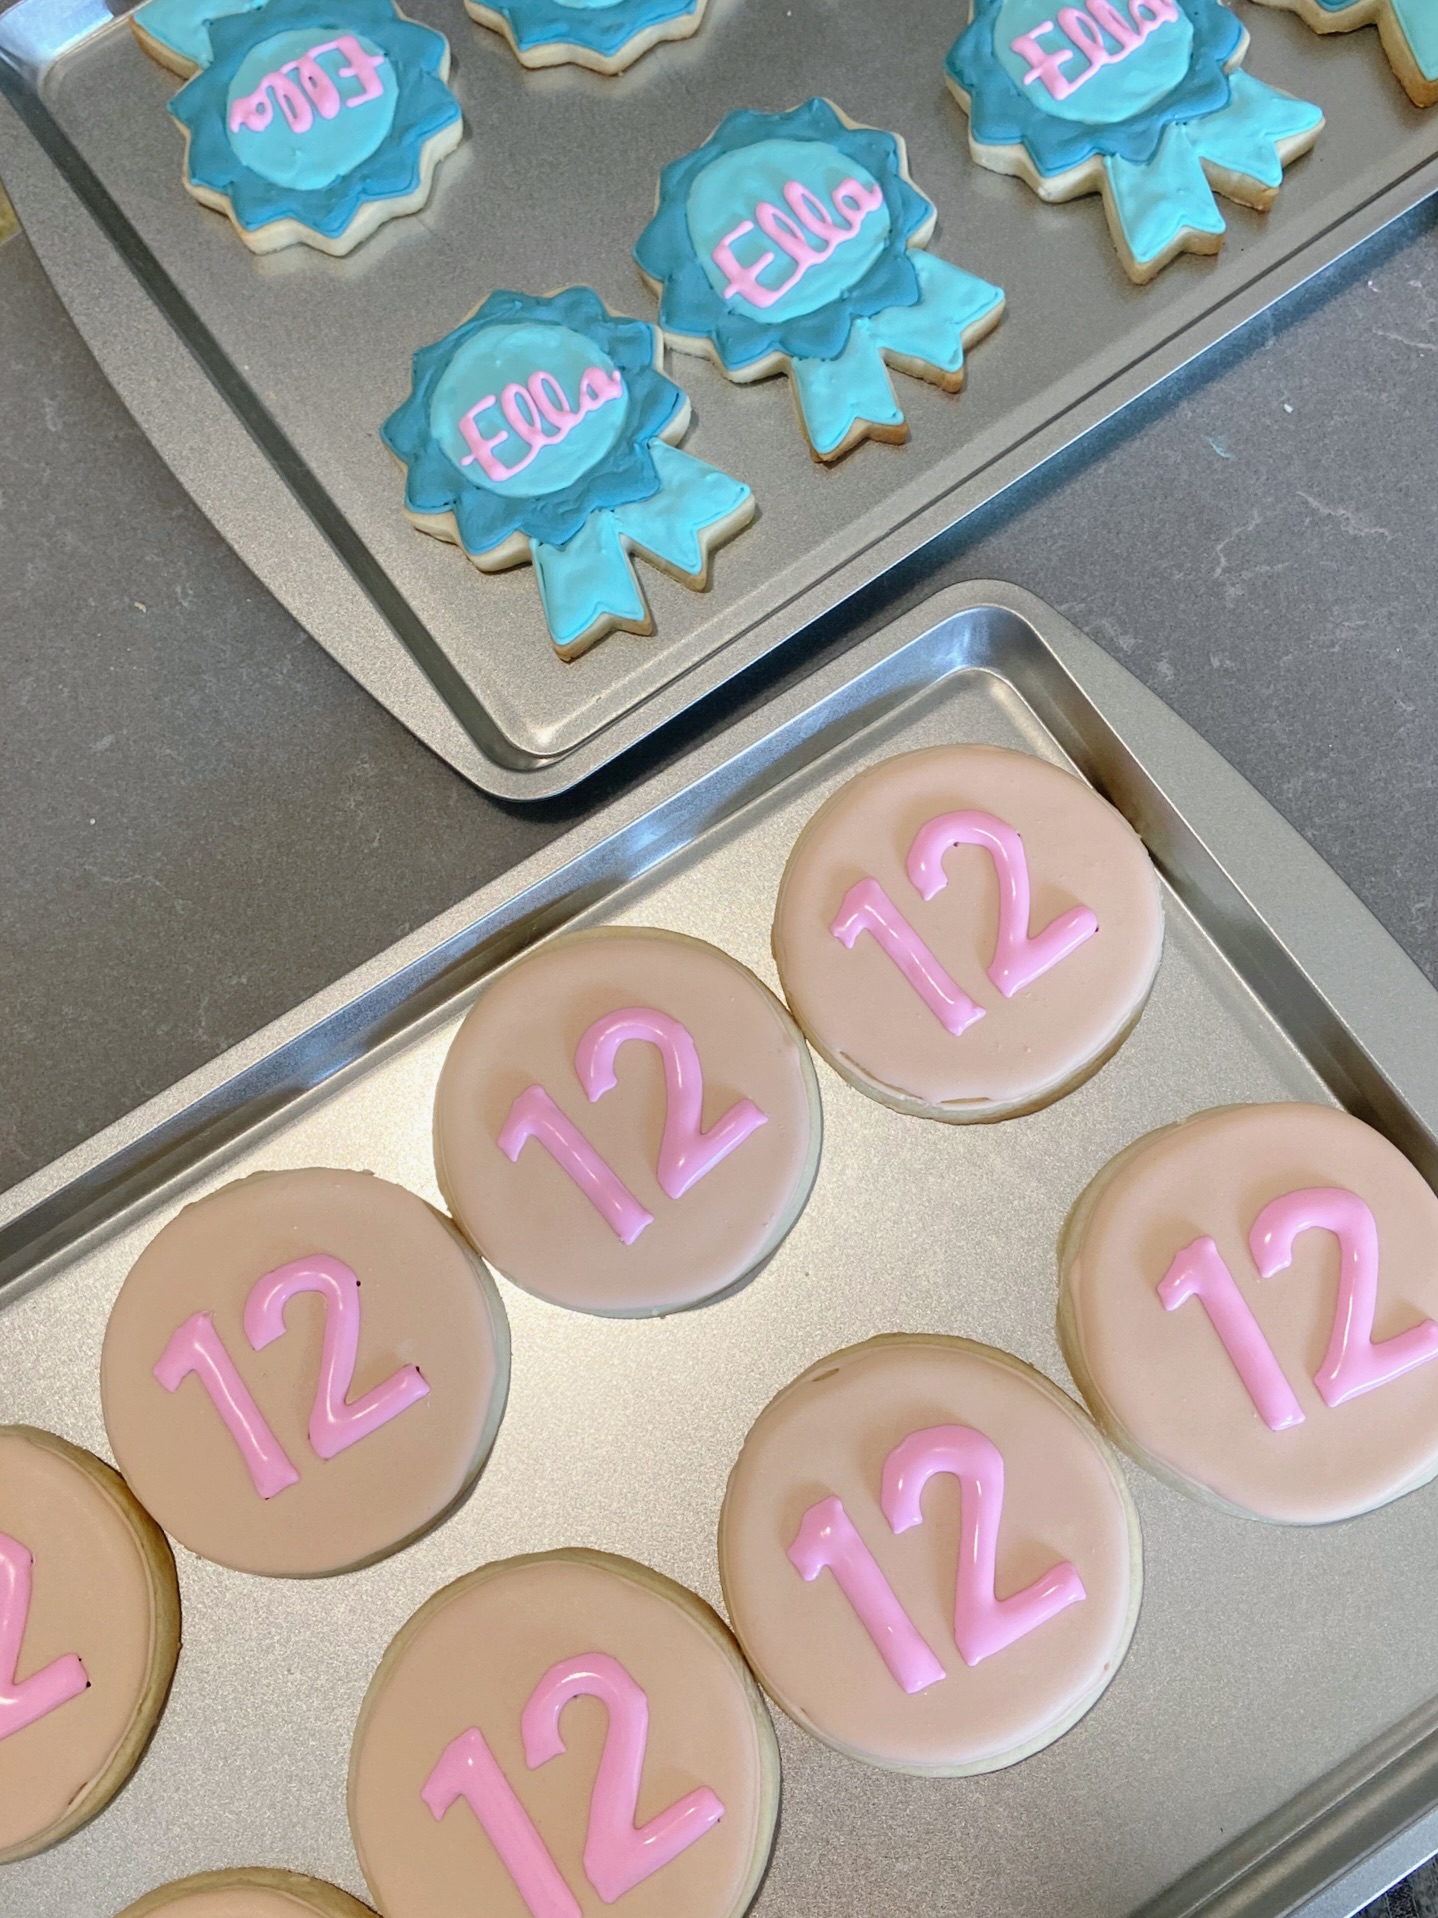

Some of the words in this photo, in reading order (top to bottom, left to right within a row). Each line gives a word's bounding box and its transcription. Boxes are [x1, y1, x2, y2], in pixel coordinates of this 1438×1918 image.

[230, 36, 385, 134] Ella
[1010, 0, 1179, 100] Ella
[714, 178, 884, 309] Ella
[460, 367, 624, 482] Ella
[831, 810, 1099, 1036] 12
[498, 1006, 768, 1246] 12
[153, 1254, 431, 1500] 12
[1157, 1187, 1438, 1431] 12
[788, 1425, 1086, 1695] 12
[421, 1652, 726, 1918] 12
